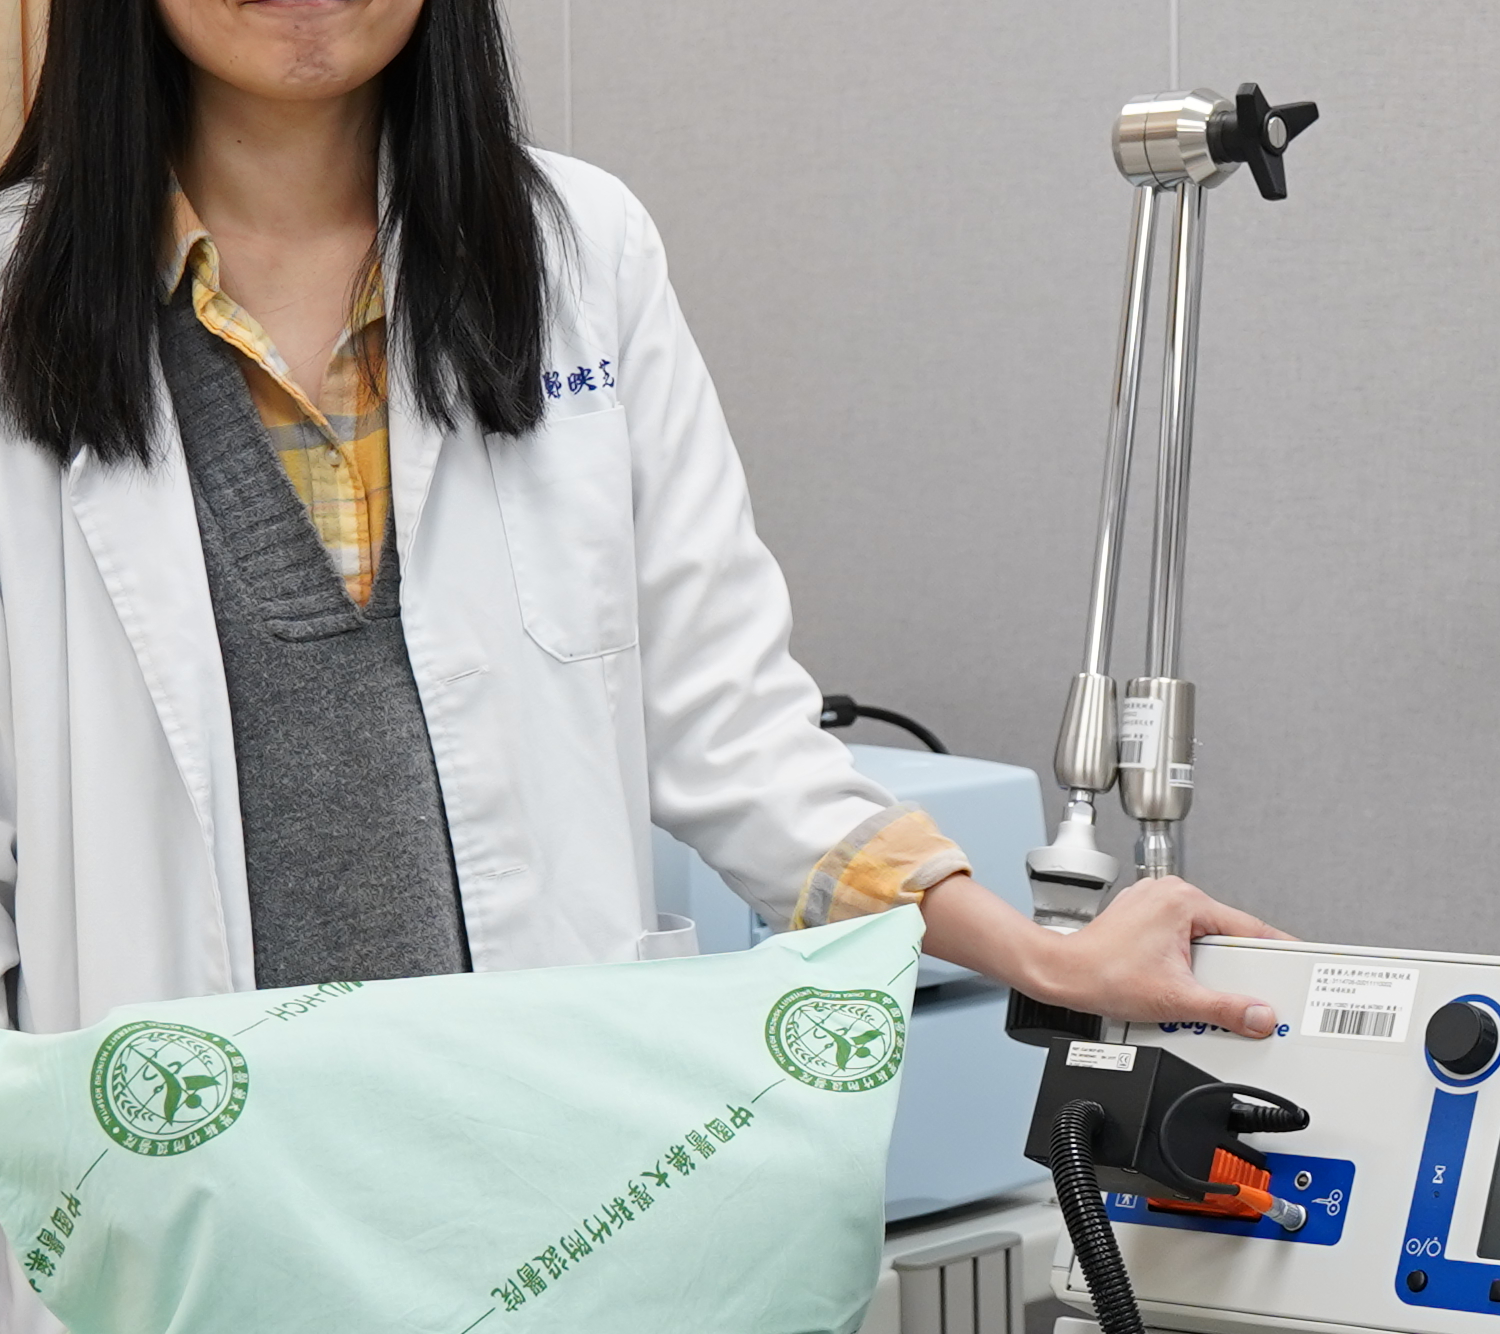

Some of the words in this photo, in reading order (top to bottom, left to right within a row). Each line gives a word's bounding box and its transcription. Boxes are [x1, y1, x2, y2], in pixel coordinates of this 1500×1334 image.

[265, 981, 363, 1021] MU-HCH
[25, 1191, 82, 1293] 中國醫藥
